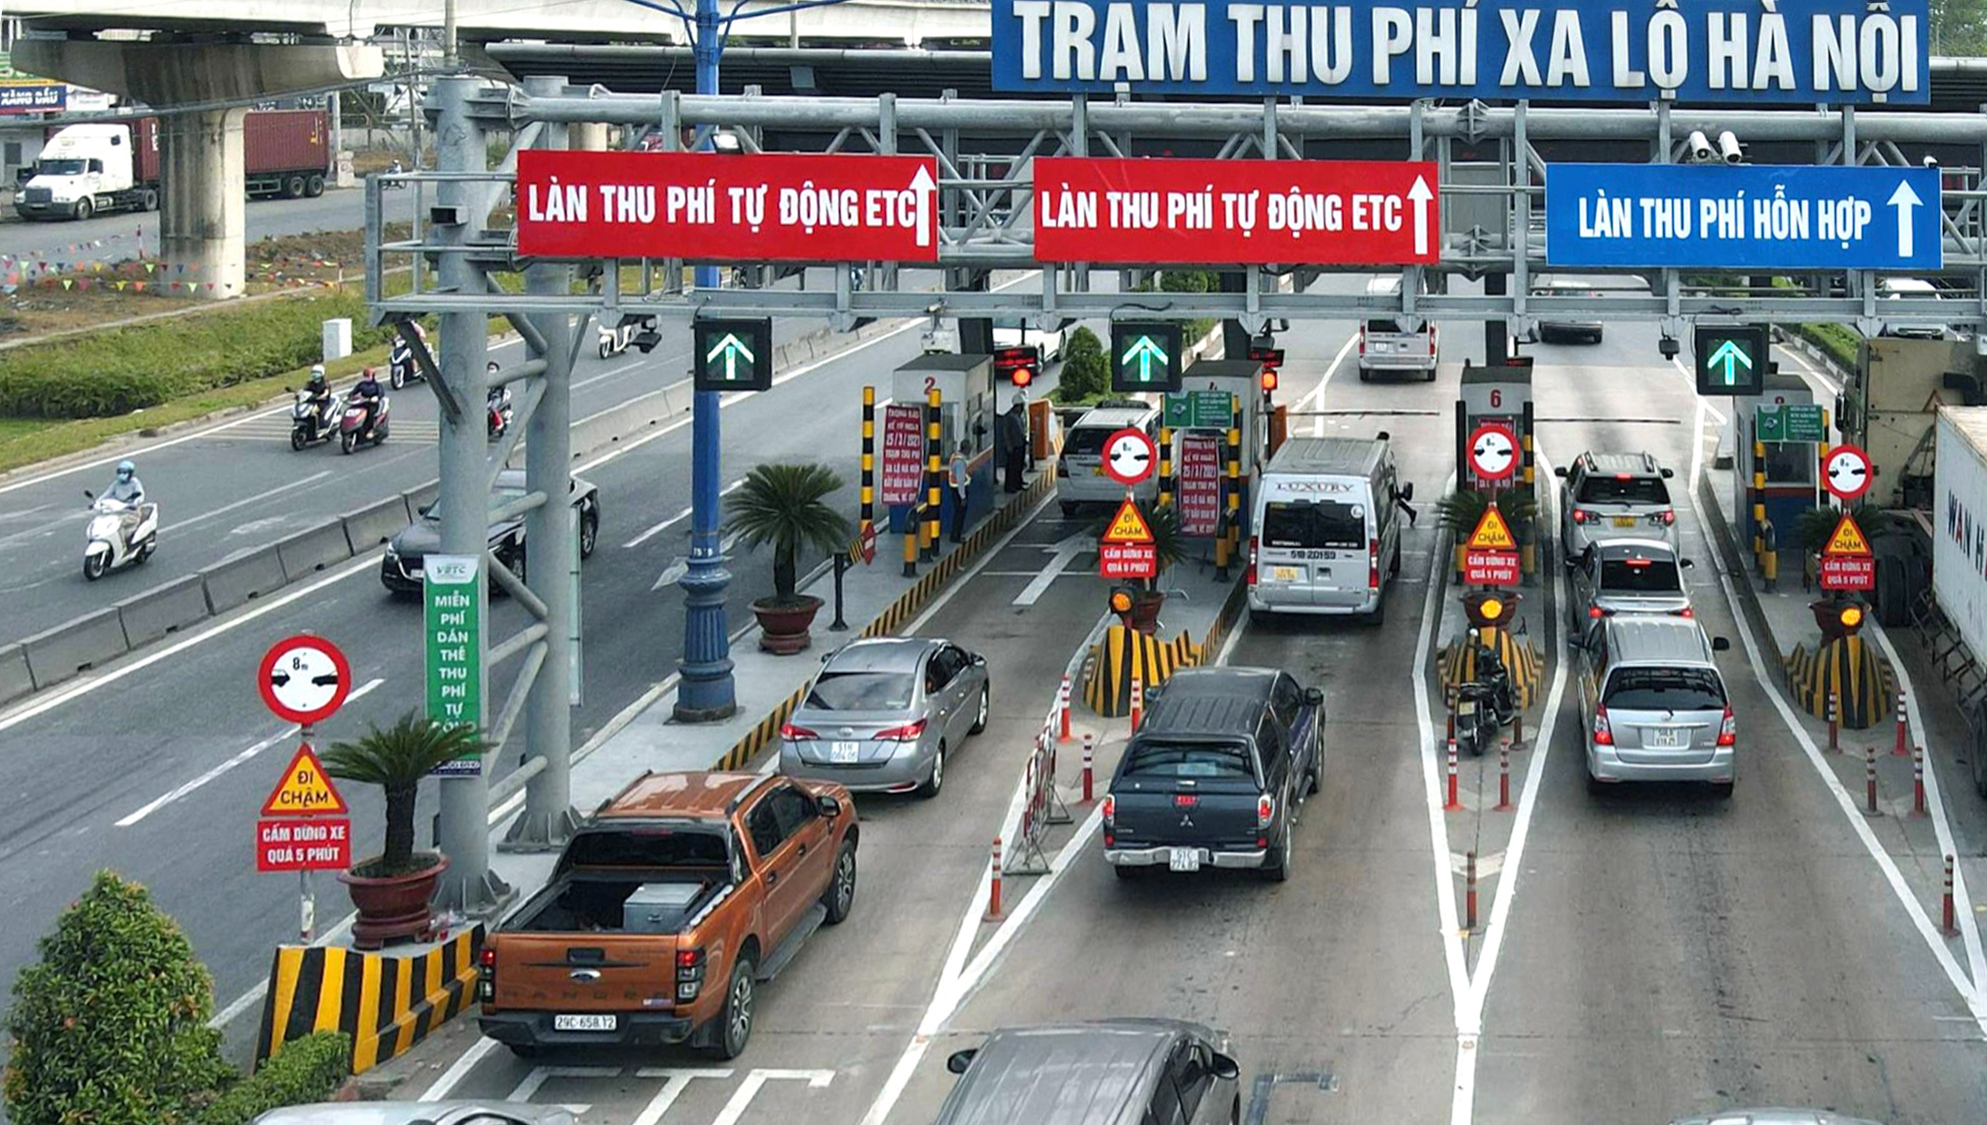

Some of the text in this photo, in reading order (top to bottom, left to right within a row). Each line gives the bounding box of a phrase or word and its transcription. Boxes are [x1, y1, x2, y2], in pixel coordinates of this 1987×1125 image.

[1013, 0, 1918, 103] TRẠM THU PHÍ XA LỘ HÀ NỘI
[529, 175, 915, 235] LÀN THU PHÍ TỰ ĐỘNG ETC
[1041, 182, 1403, 239] LÀN THU PHÍ TỰ ĐỘNG ETC
[1579, 184, 1872, 250] LÀN THU PHÍ HỖN HỢP
[1490, 389, 1502, 408] 6
[1275, 482, 1355, 493] LUXURY
[1947, 489, 1972, 559] WAN
[435, 589, 470, 608] MIỄN
[440, 611, 465, 625] PHÍ
[437, 628, 469, 643] DÁN
[439, 667, 468, 680] THU
[441, 683, 467, 697] PHÍ
[445, 704, 464, 722] TỰ
[297, 770, 314, 784] ĐI
[280, 787, 329, 808] CHẬM
[262, 822, 290, 842] CẤM
[330, 825, 345, 840] XE
[267, 842, 340, 863] QUÁ 5 PHÚT
